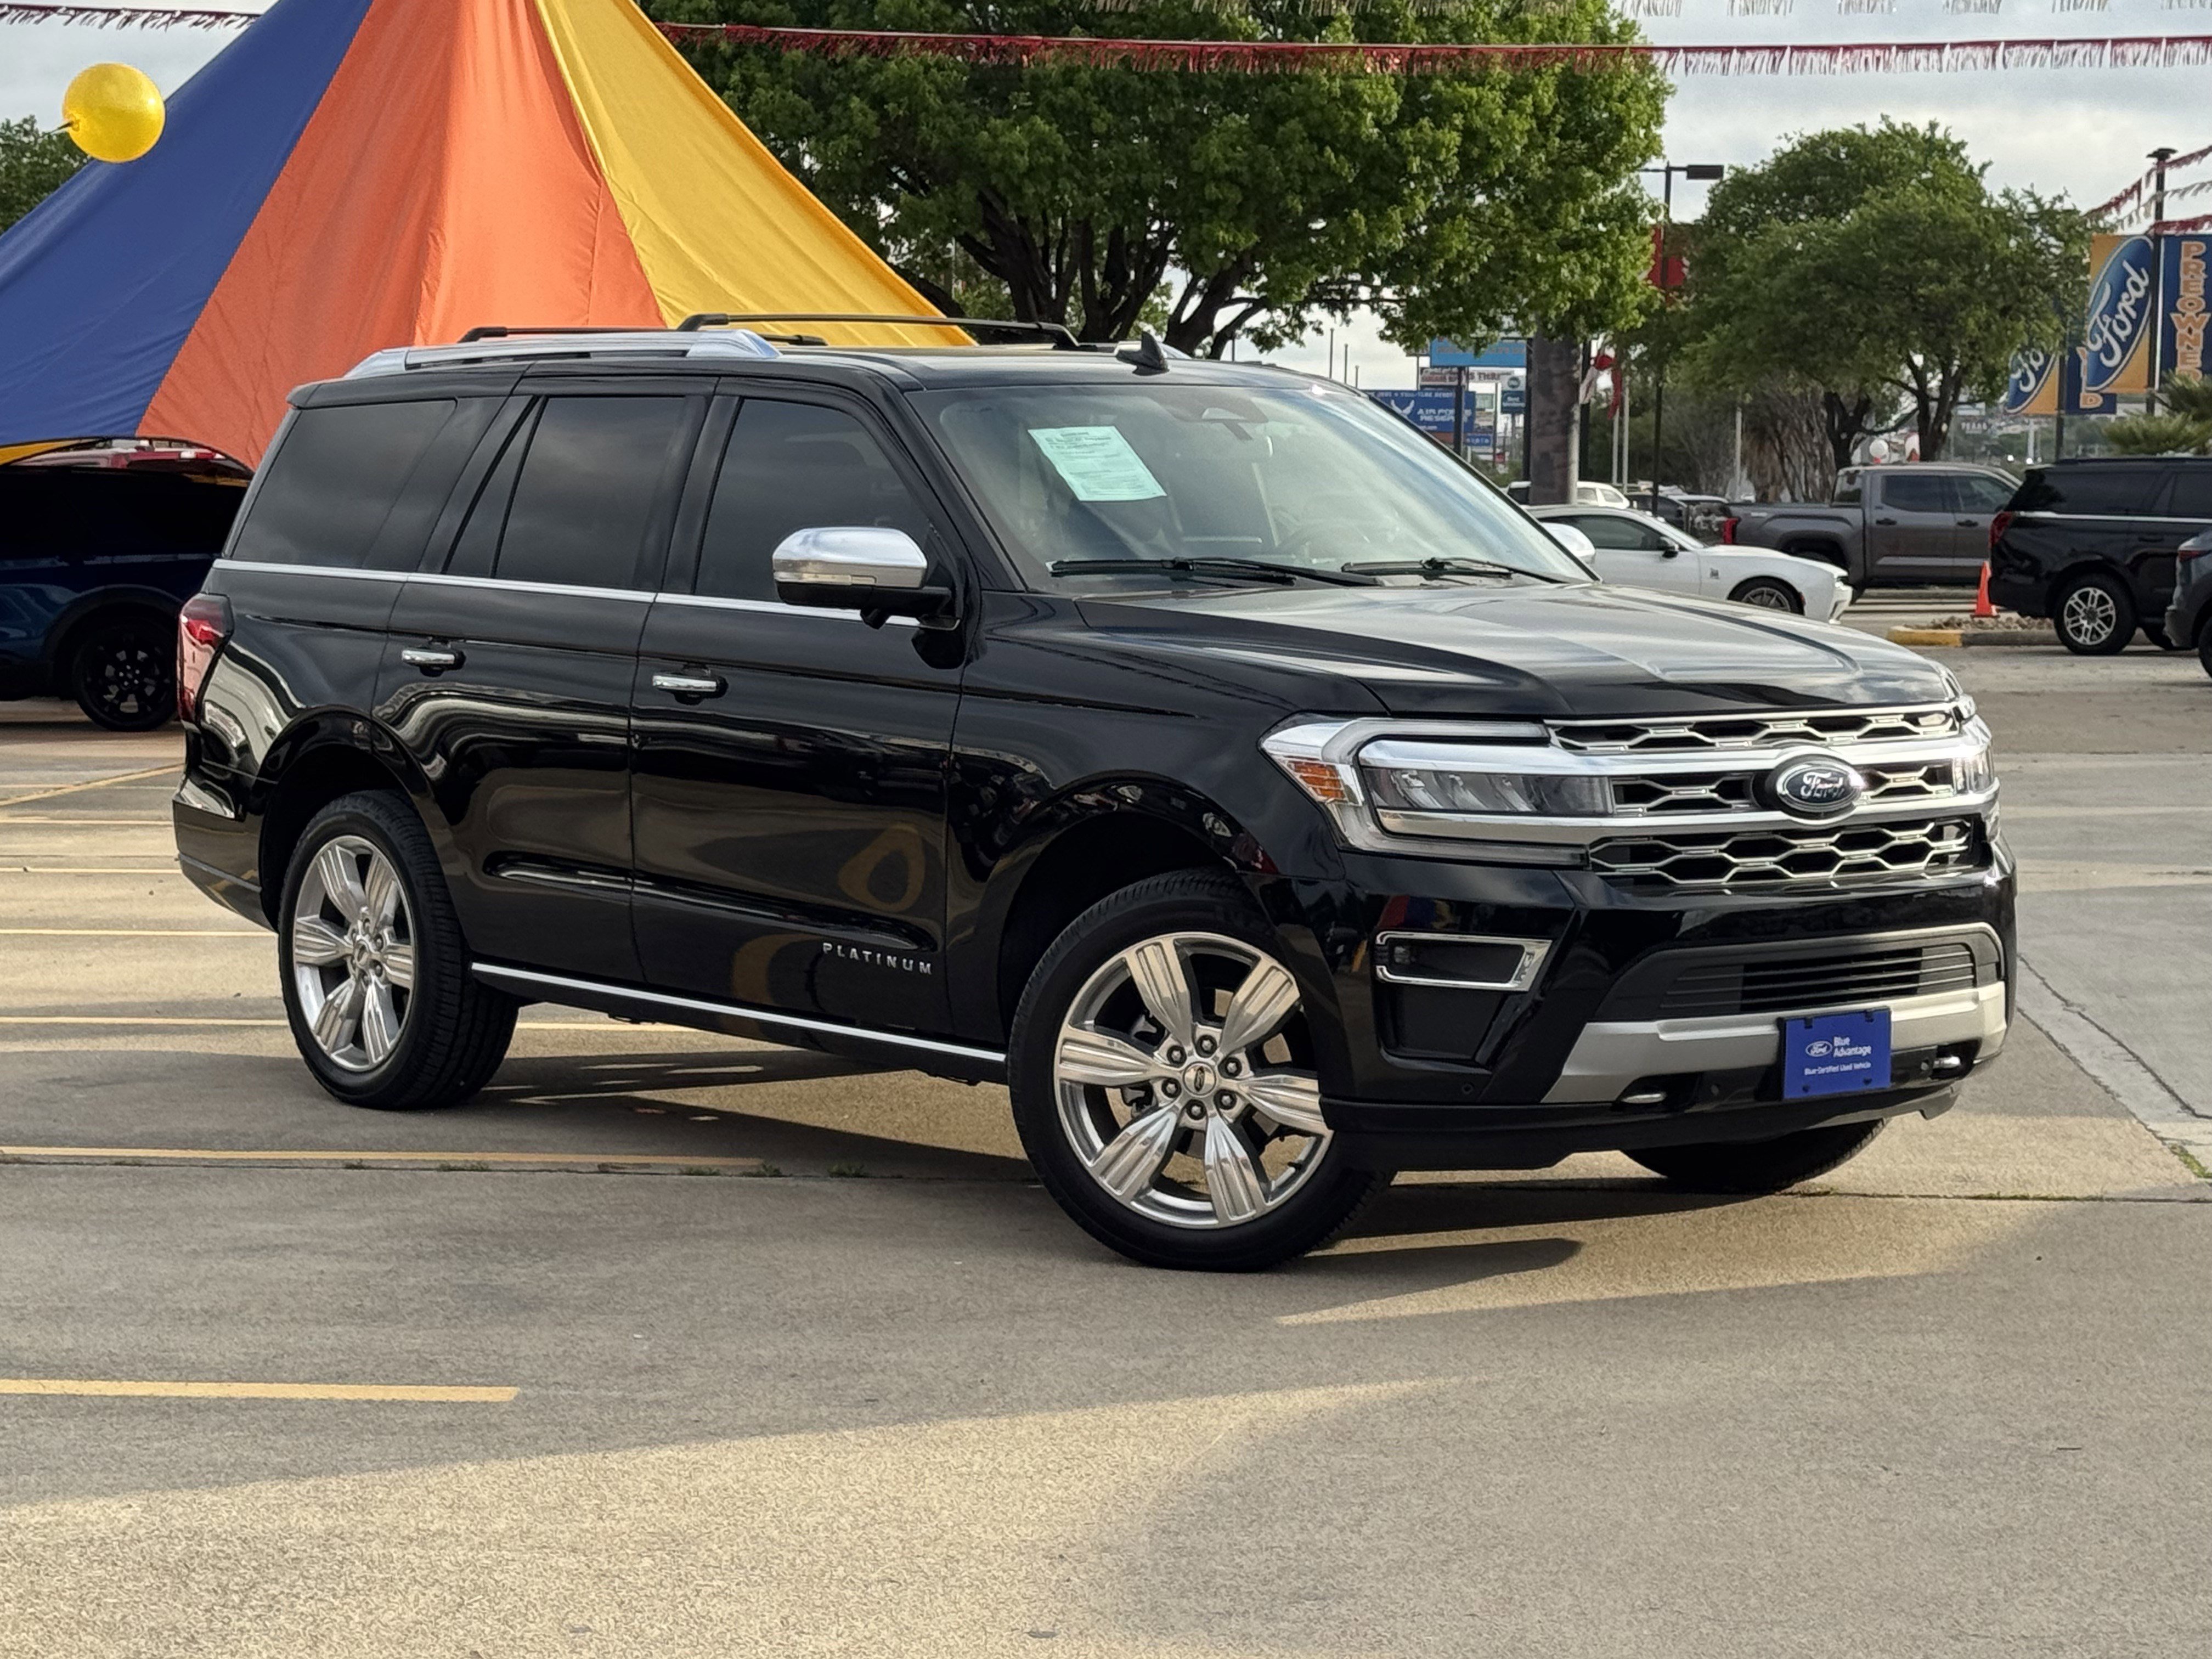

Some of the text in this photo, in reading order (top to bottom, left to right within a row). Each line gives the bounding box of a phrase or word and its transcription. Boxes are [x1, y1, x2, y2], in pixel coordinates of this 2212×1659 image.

[2086, 259, 2149, 368] Ford
[1800, 771, 1844, 799] Ford
[823, 942, 932, 975] PLATINUM
[1833, 1036, 1850, 1047] Blue
[1833, 1045, 1872, 1058] Advantage
